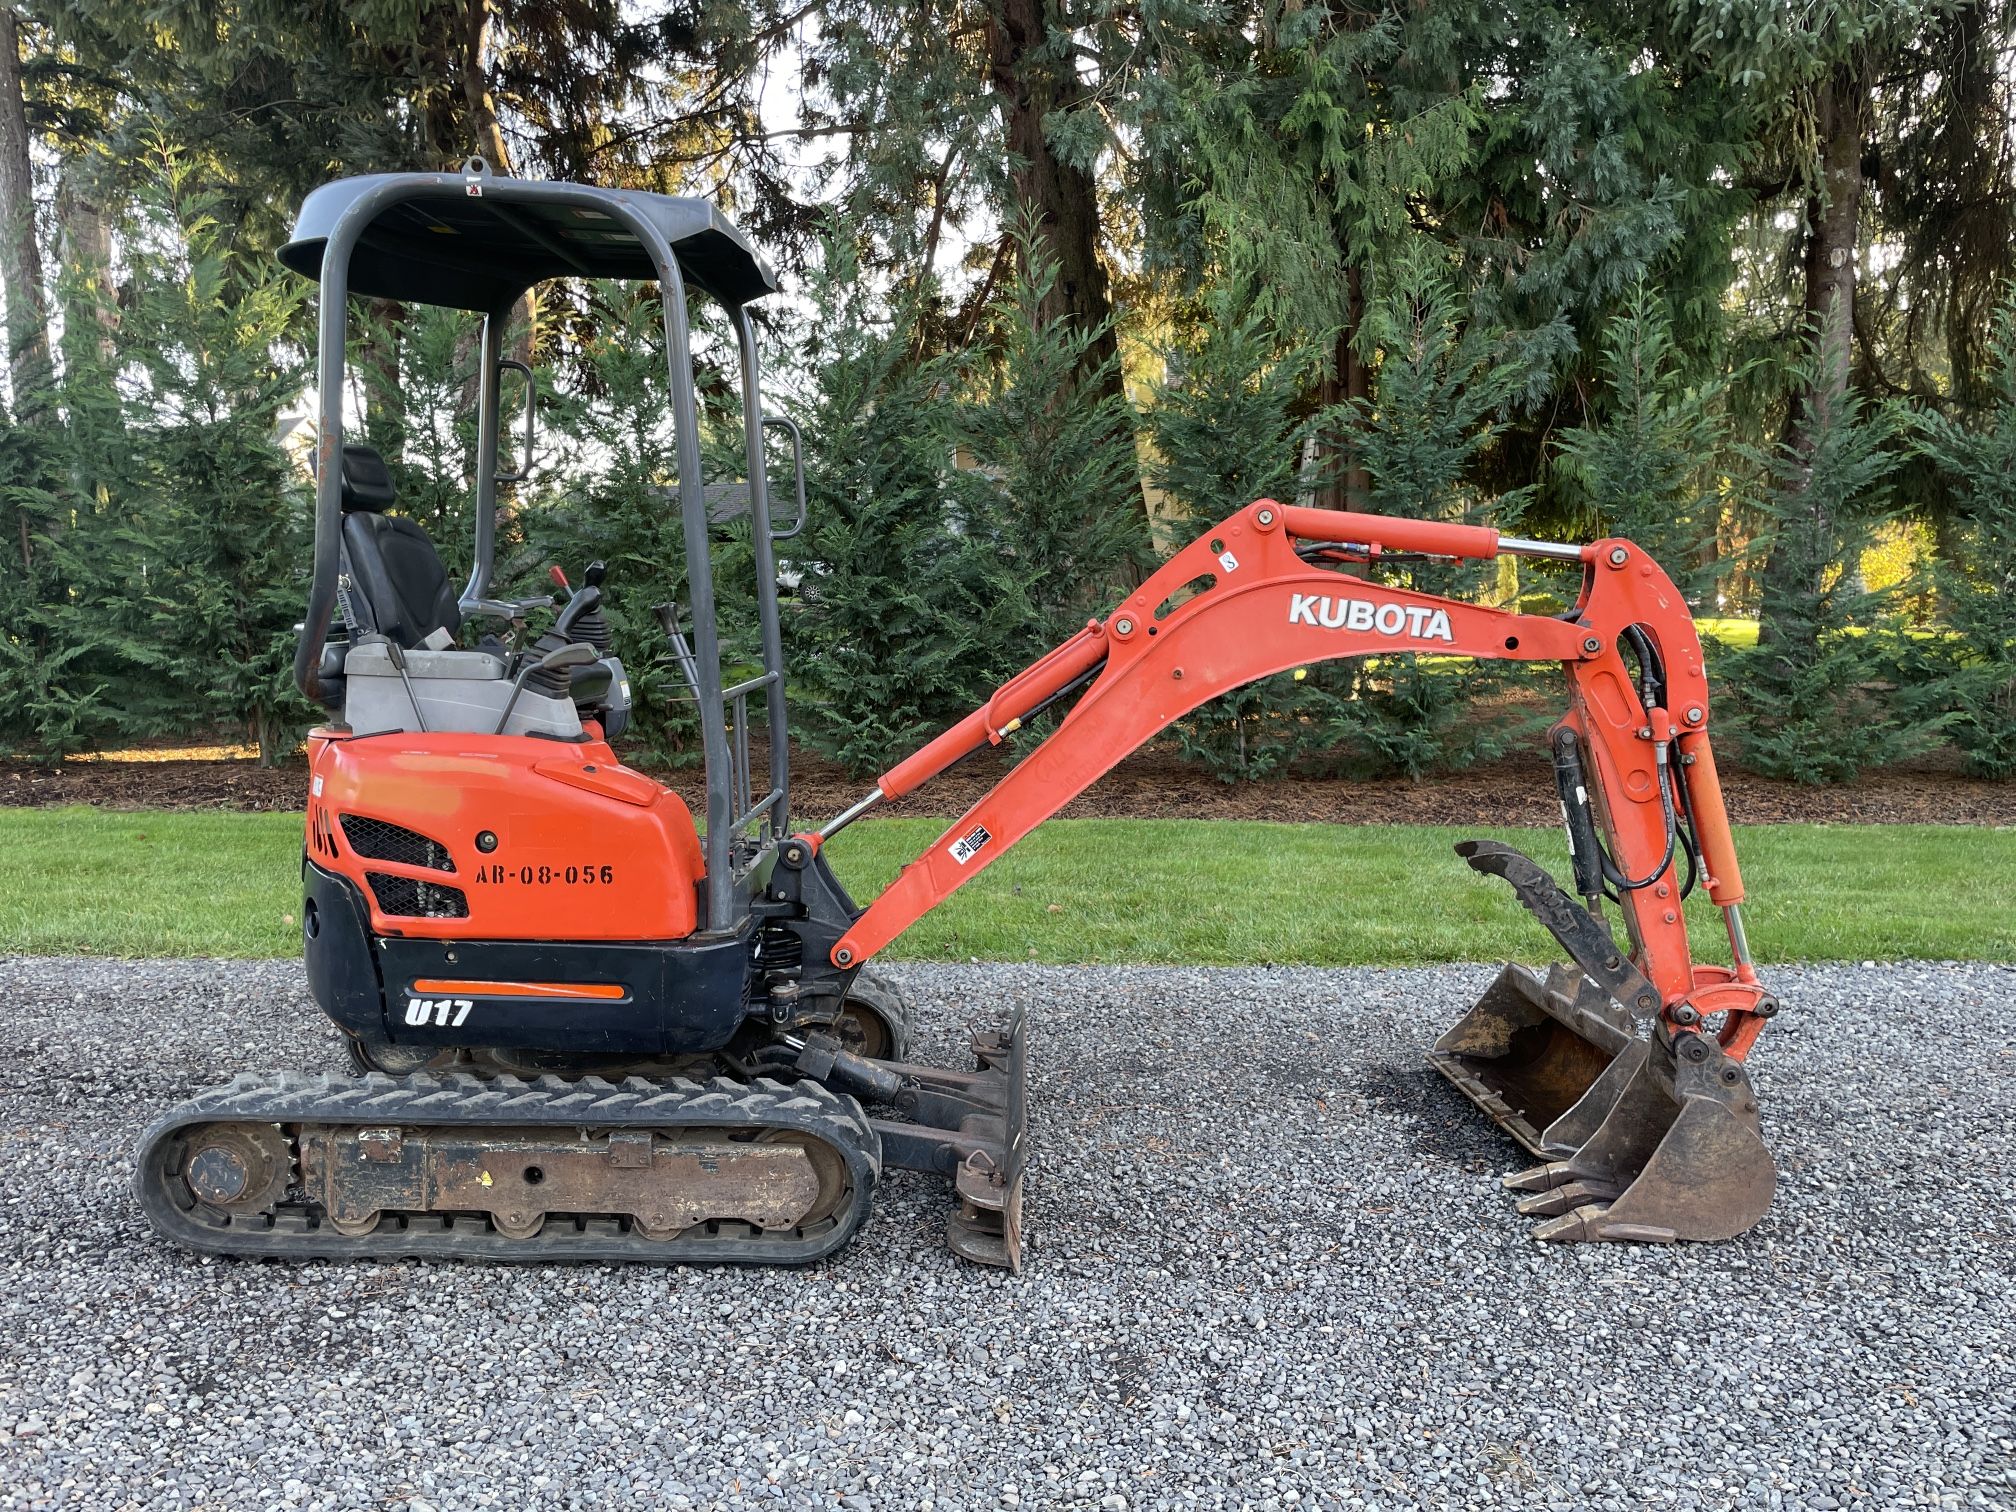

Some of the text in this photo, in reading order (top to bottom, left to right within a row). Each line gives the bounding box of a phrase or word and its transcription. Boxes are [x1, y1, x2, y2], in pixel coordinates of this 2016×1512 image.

[1289, 593, 1453, 641] KUBOTA
[475, 865, 613, 885] AR-08-056
[405, 999, 473, 1027] U17
